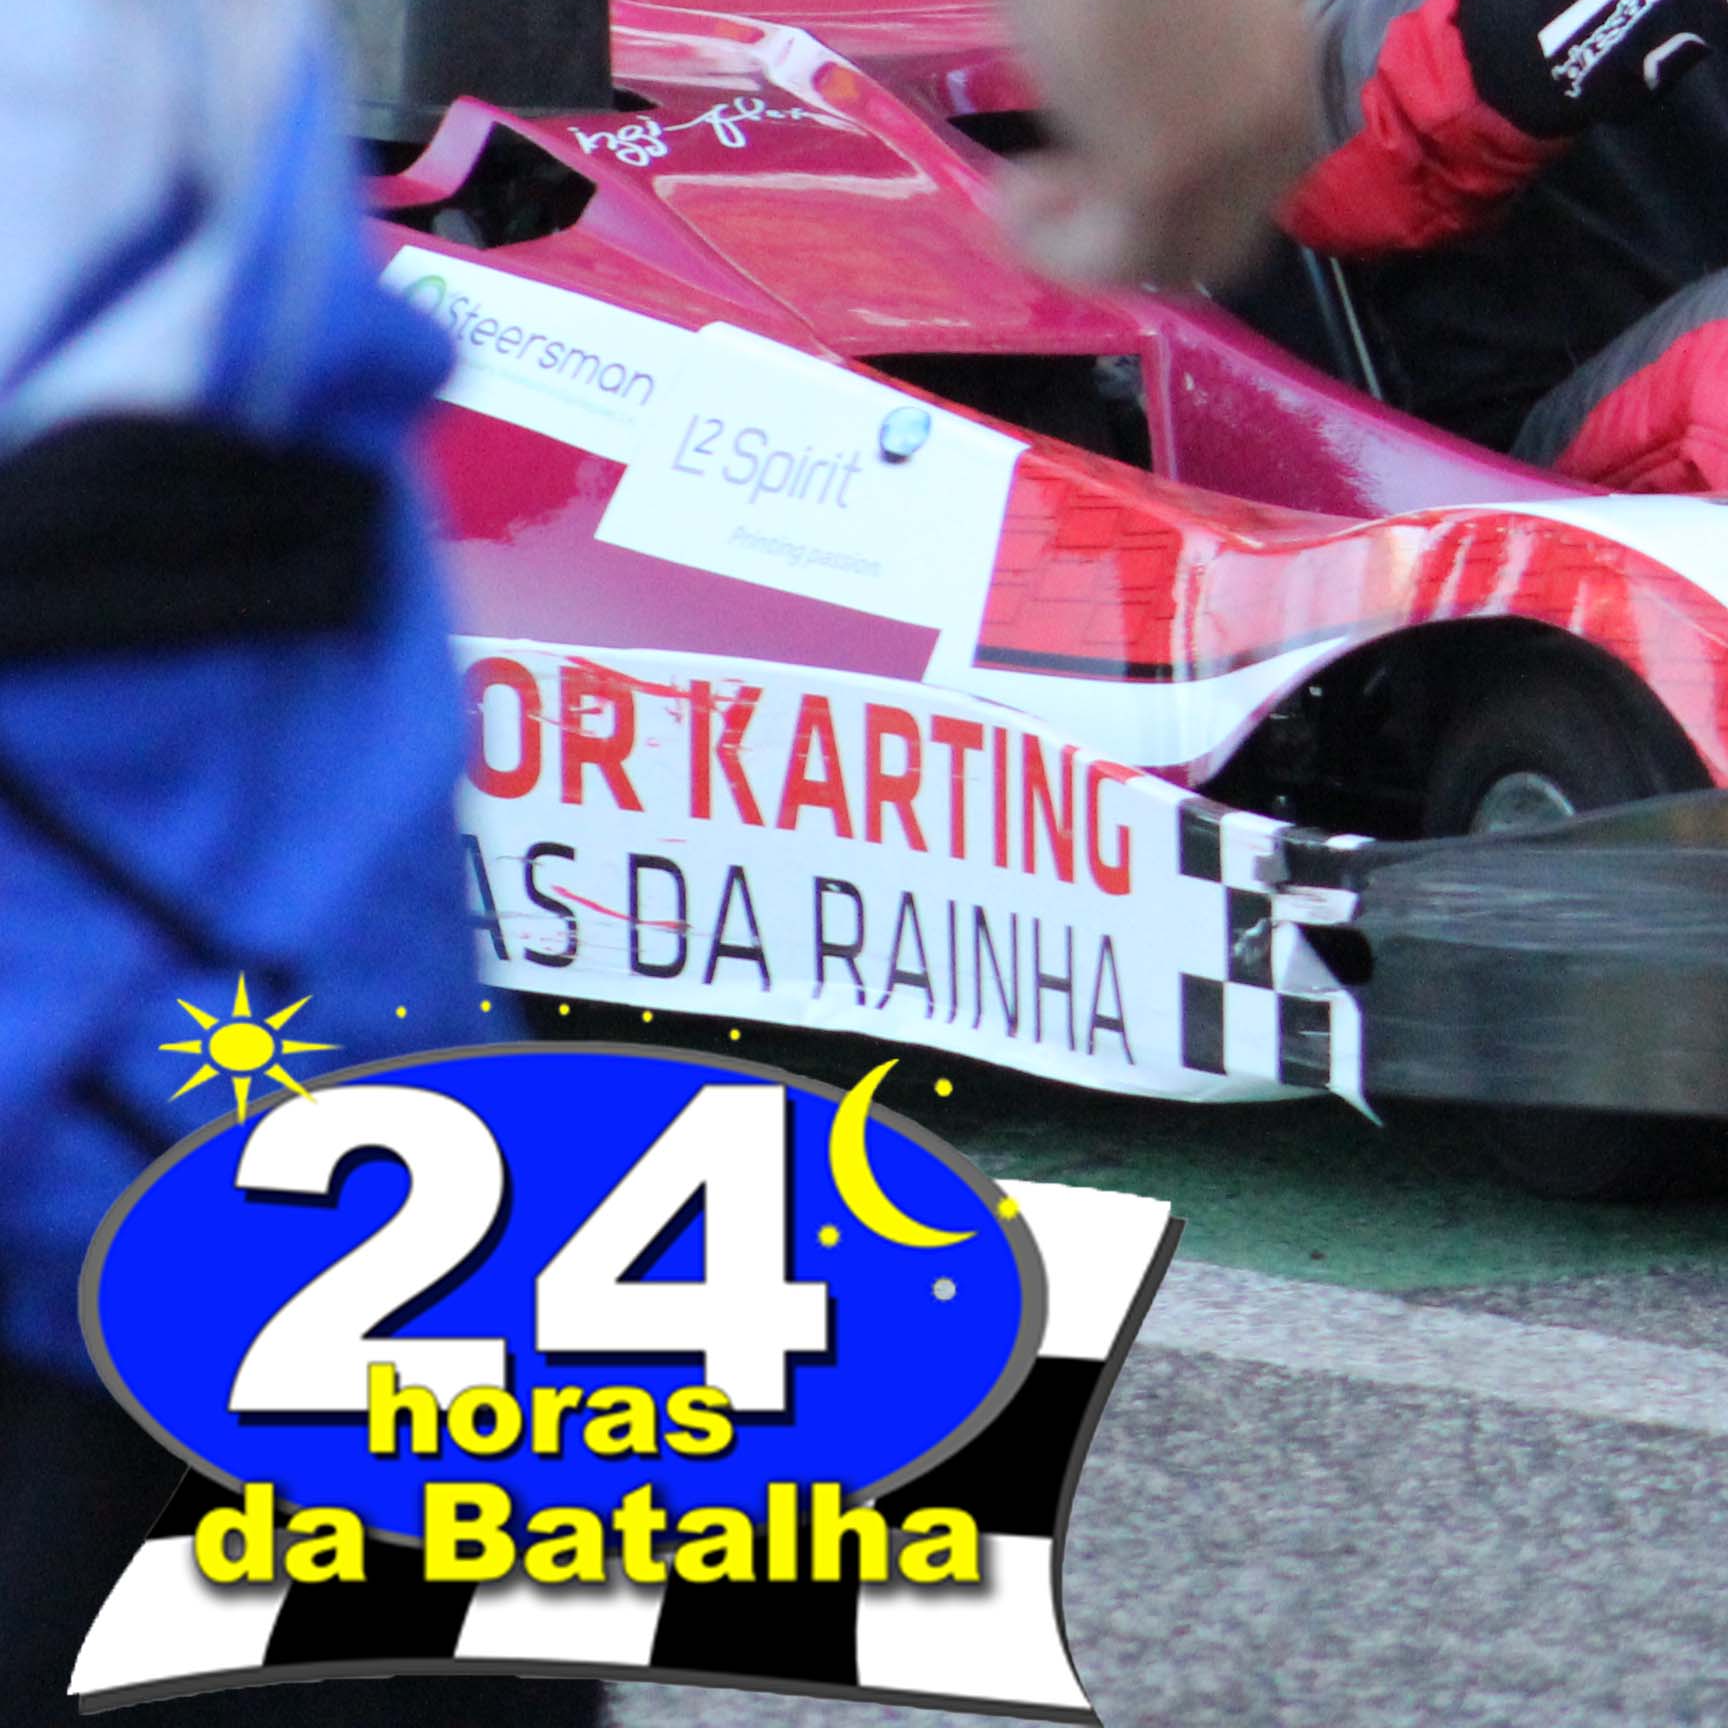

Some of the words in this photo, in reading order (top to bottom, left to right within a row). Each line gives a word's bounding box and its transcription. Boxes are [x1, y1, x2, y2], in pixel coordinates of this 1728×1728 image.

[448, 293, 656, 406] Steersman
[722, 426, 863, 509] Spirit
[690, 678, 1131, 897] KARTING
[627, 851, 773, 992] DA
[815, 876, 1136, 1067] RAINHA
